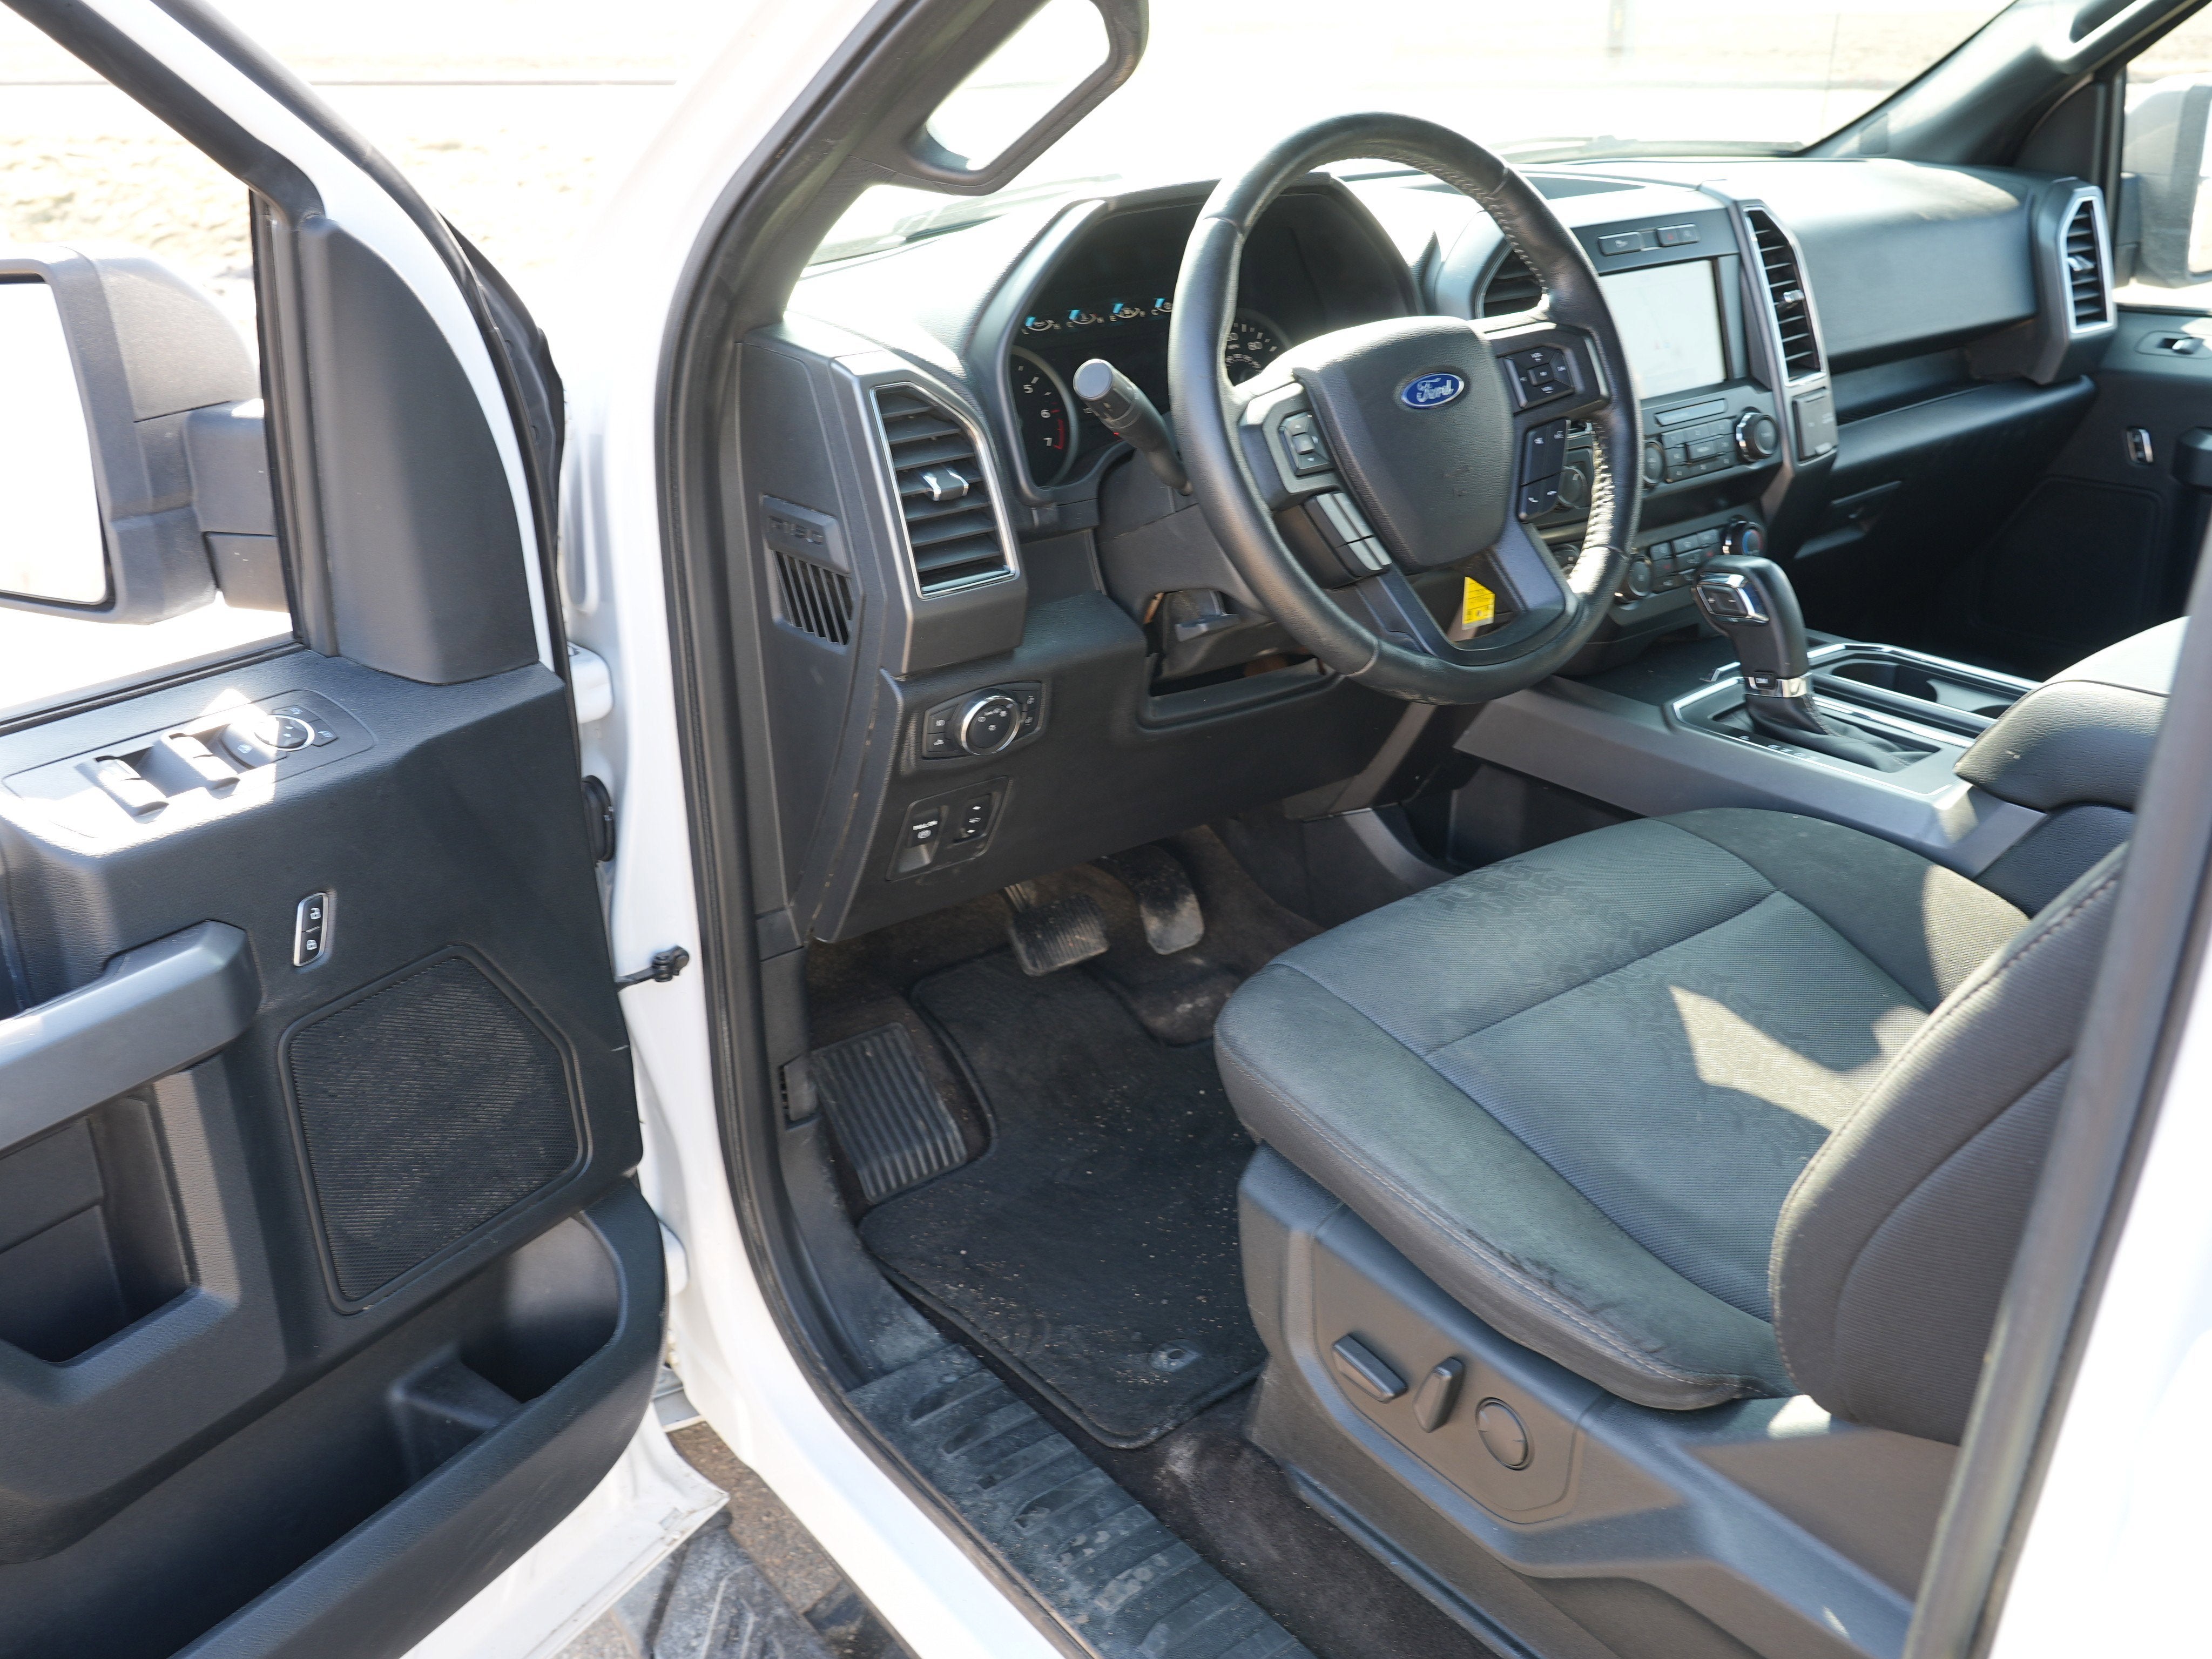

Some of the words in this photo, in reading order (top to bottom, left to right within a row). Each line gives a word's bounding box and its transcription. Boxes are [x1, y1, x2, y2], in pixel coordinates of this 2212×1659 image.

[1247, 341, 1263, 350] 80
[1023, 384, 1033, 393] 5
[1416, 377, 1454, 402] Ford
[1040, 409, 1051, 418] 6
[1042, 437, 1053, 446] 7
